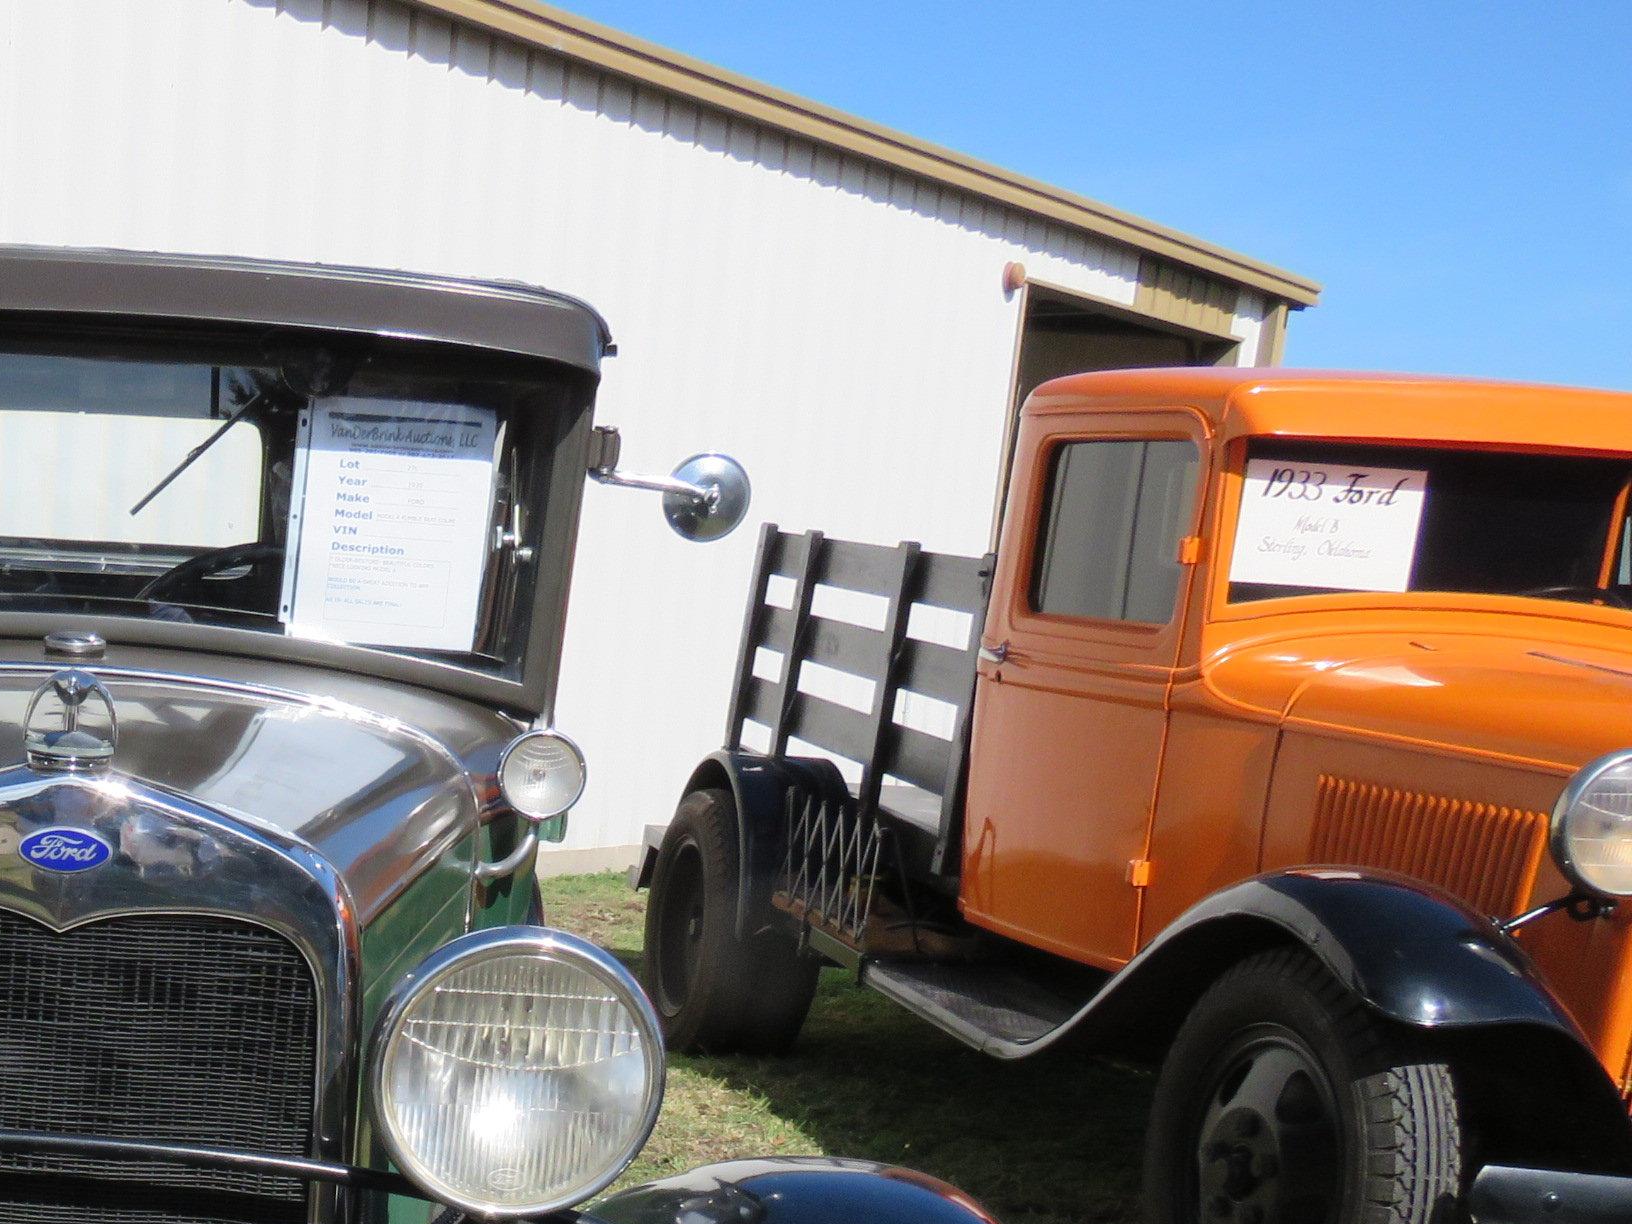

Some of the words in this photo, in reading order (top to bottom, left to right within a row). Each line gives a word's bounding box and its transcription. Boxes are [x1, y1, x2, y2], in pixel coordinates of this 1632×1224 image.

[460, 432, 478, 448] LLC
[339, 459, 360, 470] Lot
[338, 475, 368, 487] Year
[1262, 468, 1327, 501] 1933
[1332, 473, 1410, 506] Ford
[336, 491, 370, 504] Make
[334, 508, 373, 520] Model
[333, 525, 358, 536] VIN
[331, 541, 405, 556] Description
[31, 834, 98, 862] Ford
